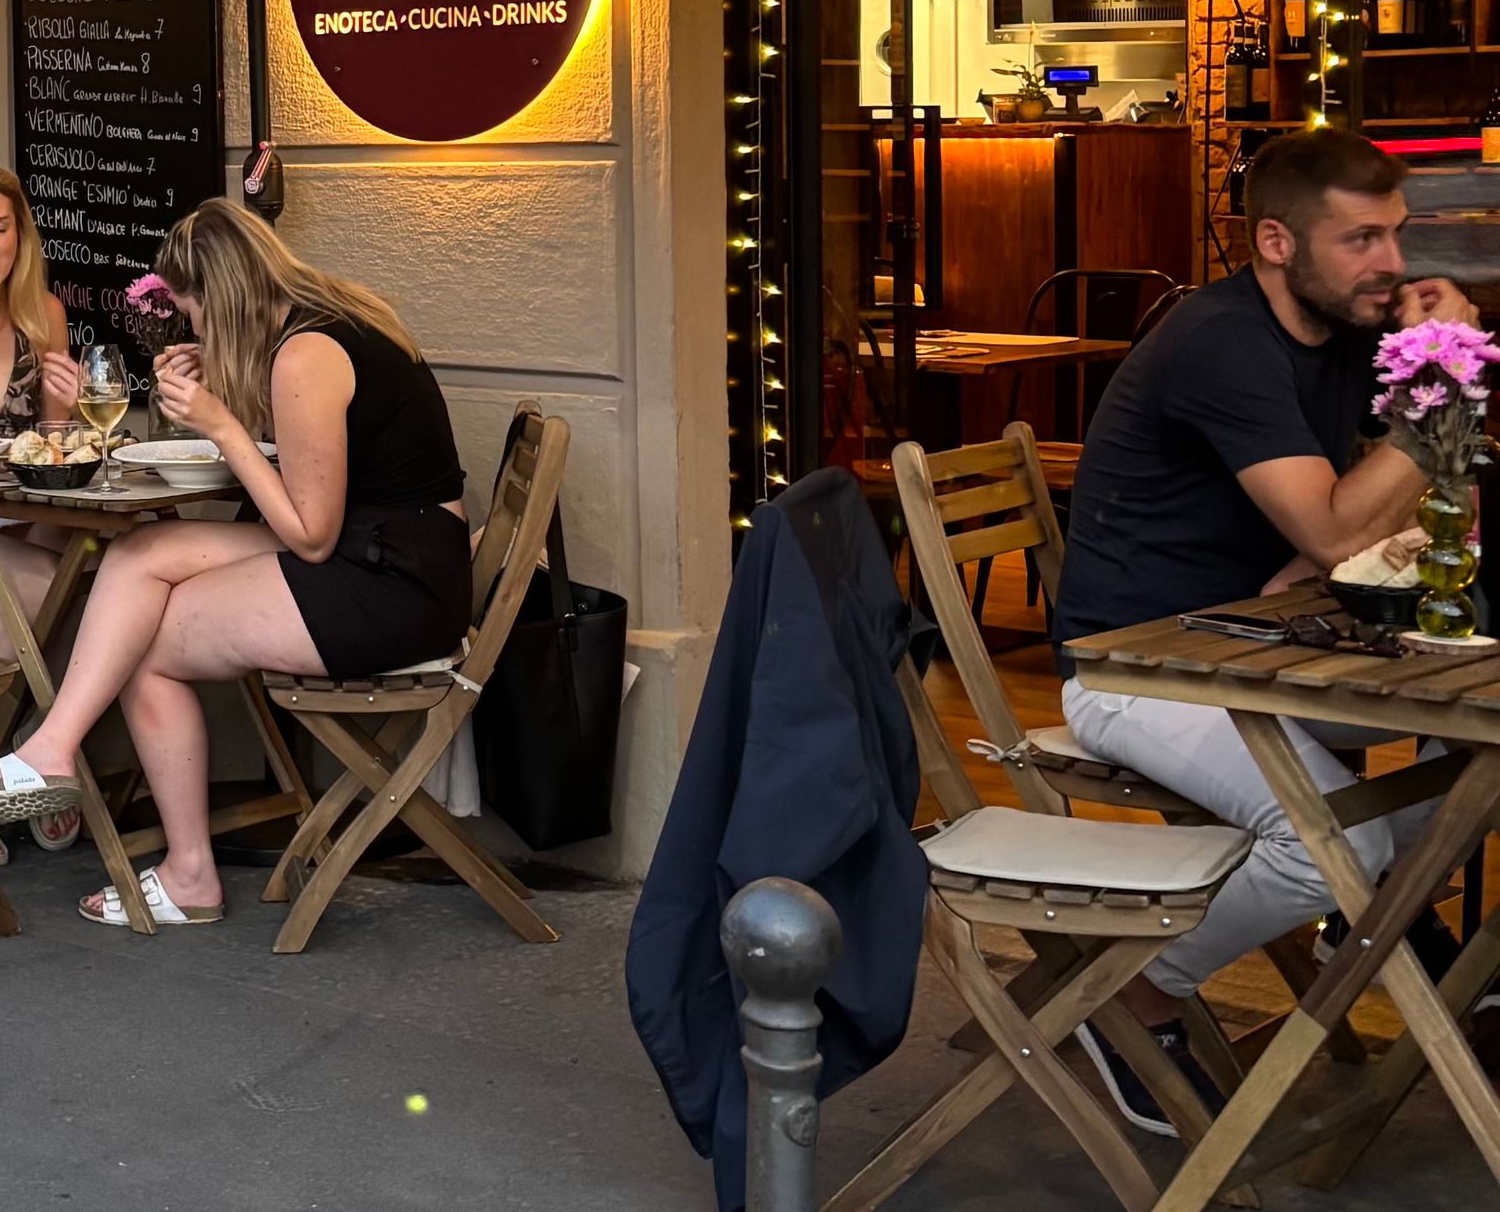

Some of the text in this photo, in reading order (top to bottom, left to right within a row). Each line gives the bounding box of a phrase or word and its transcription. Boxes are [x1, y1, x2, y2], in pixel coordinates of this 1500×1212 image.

[27, 16, 76, 39] RIBOLLA
[79, 20, 110, 40] GIALLA
[154, 18, 164, 40] 7
[27, 45, 93, 72] PASSERINA
[141, 52, 150, 74] 8
[29, 76, 71, 102] BLANC
[27, 107, 104, 138] VERMENTINO
[190, 127, 199, 142] 9
[29, 143, 95, 171] CERASUOLO
[146, 157, 156, 176] 7
[29, 174, 78, 201] ORANGE
[165, 188, 174, 207] 9
[41, 239, 91, 264] ROSECCO
